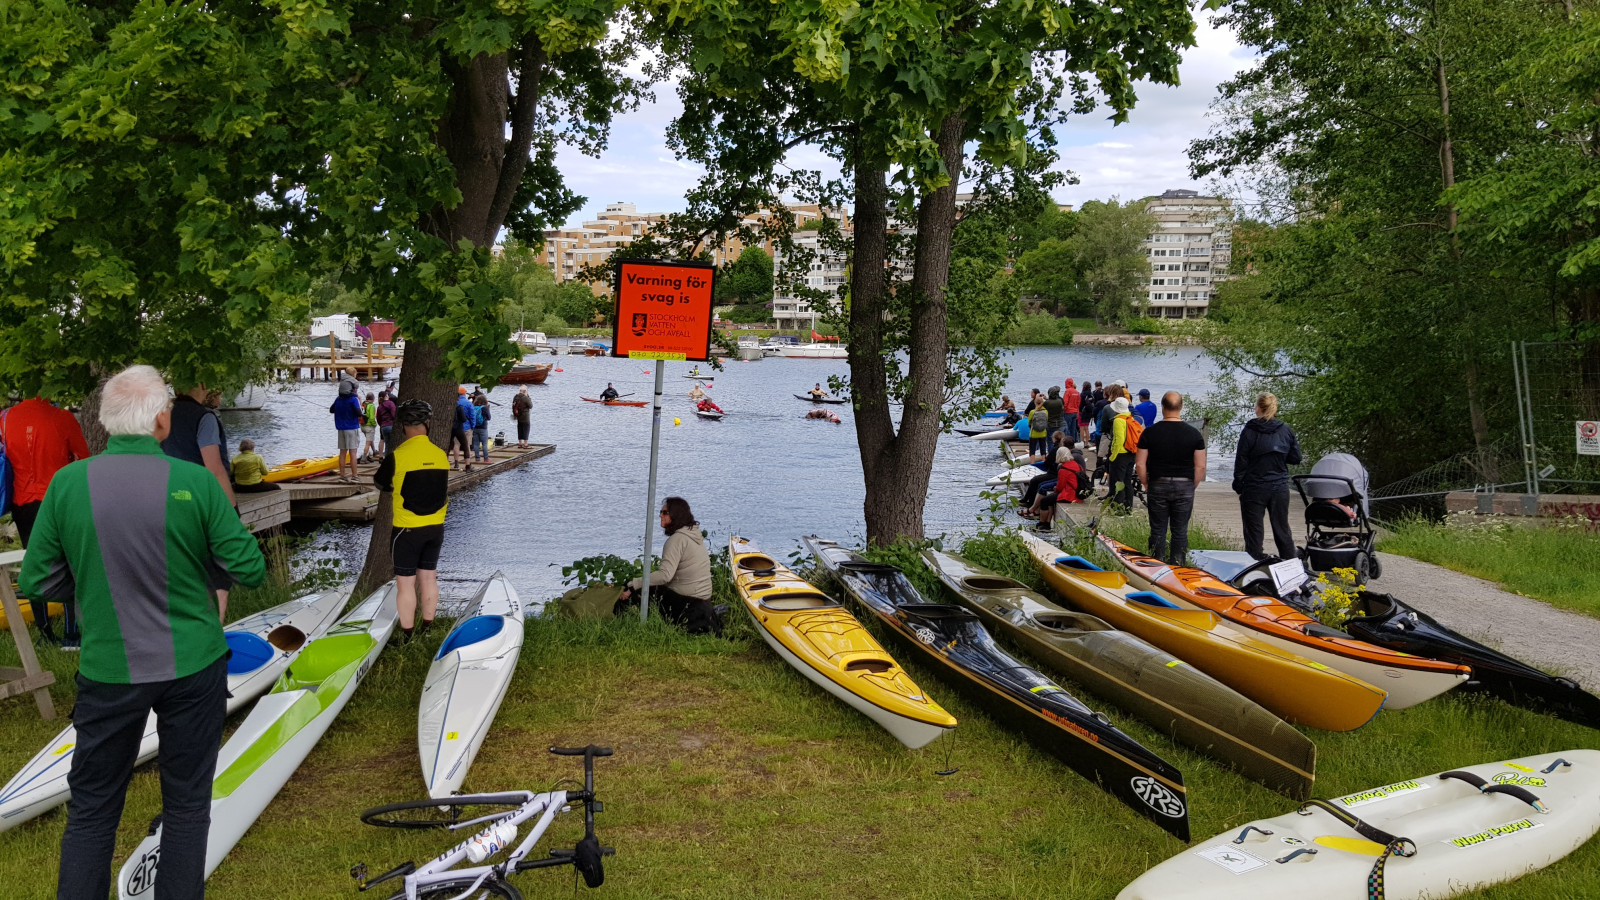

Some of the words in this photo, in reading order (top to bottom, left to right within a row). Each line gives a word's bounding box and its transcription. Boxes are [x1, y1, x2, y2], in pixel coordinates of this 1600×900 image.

[626, 273, 682, 290] Varning
[686, 275, 707, 289] för
[641, 293, 674, 306] svag
[679, 292, 690, 304] is
[649, 313, 696, 323] STOCKHOLM
[649, 321, 676, 329] VATTEN
[647, 329, 665, 337] OCH
[666, 330, 691, 338] AVFALL
[1382, 780, 1420, 793] Wave
[1340, 789, 1388, 806] Patrol
[1451, 832, 1494, 848] Wave
[1486, 819, 1535, 836] Patrol
